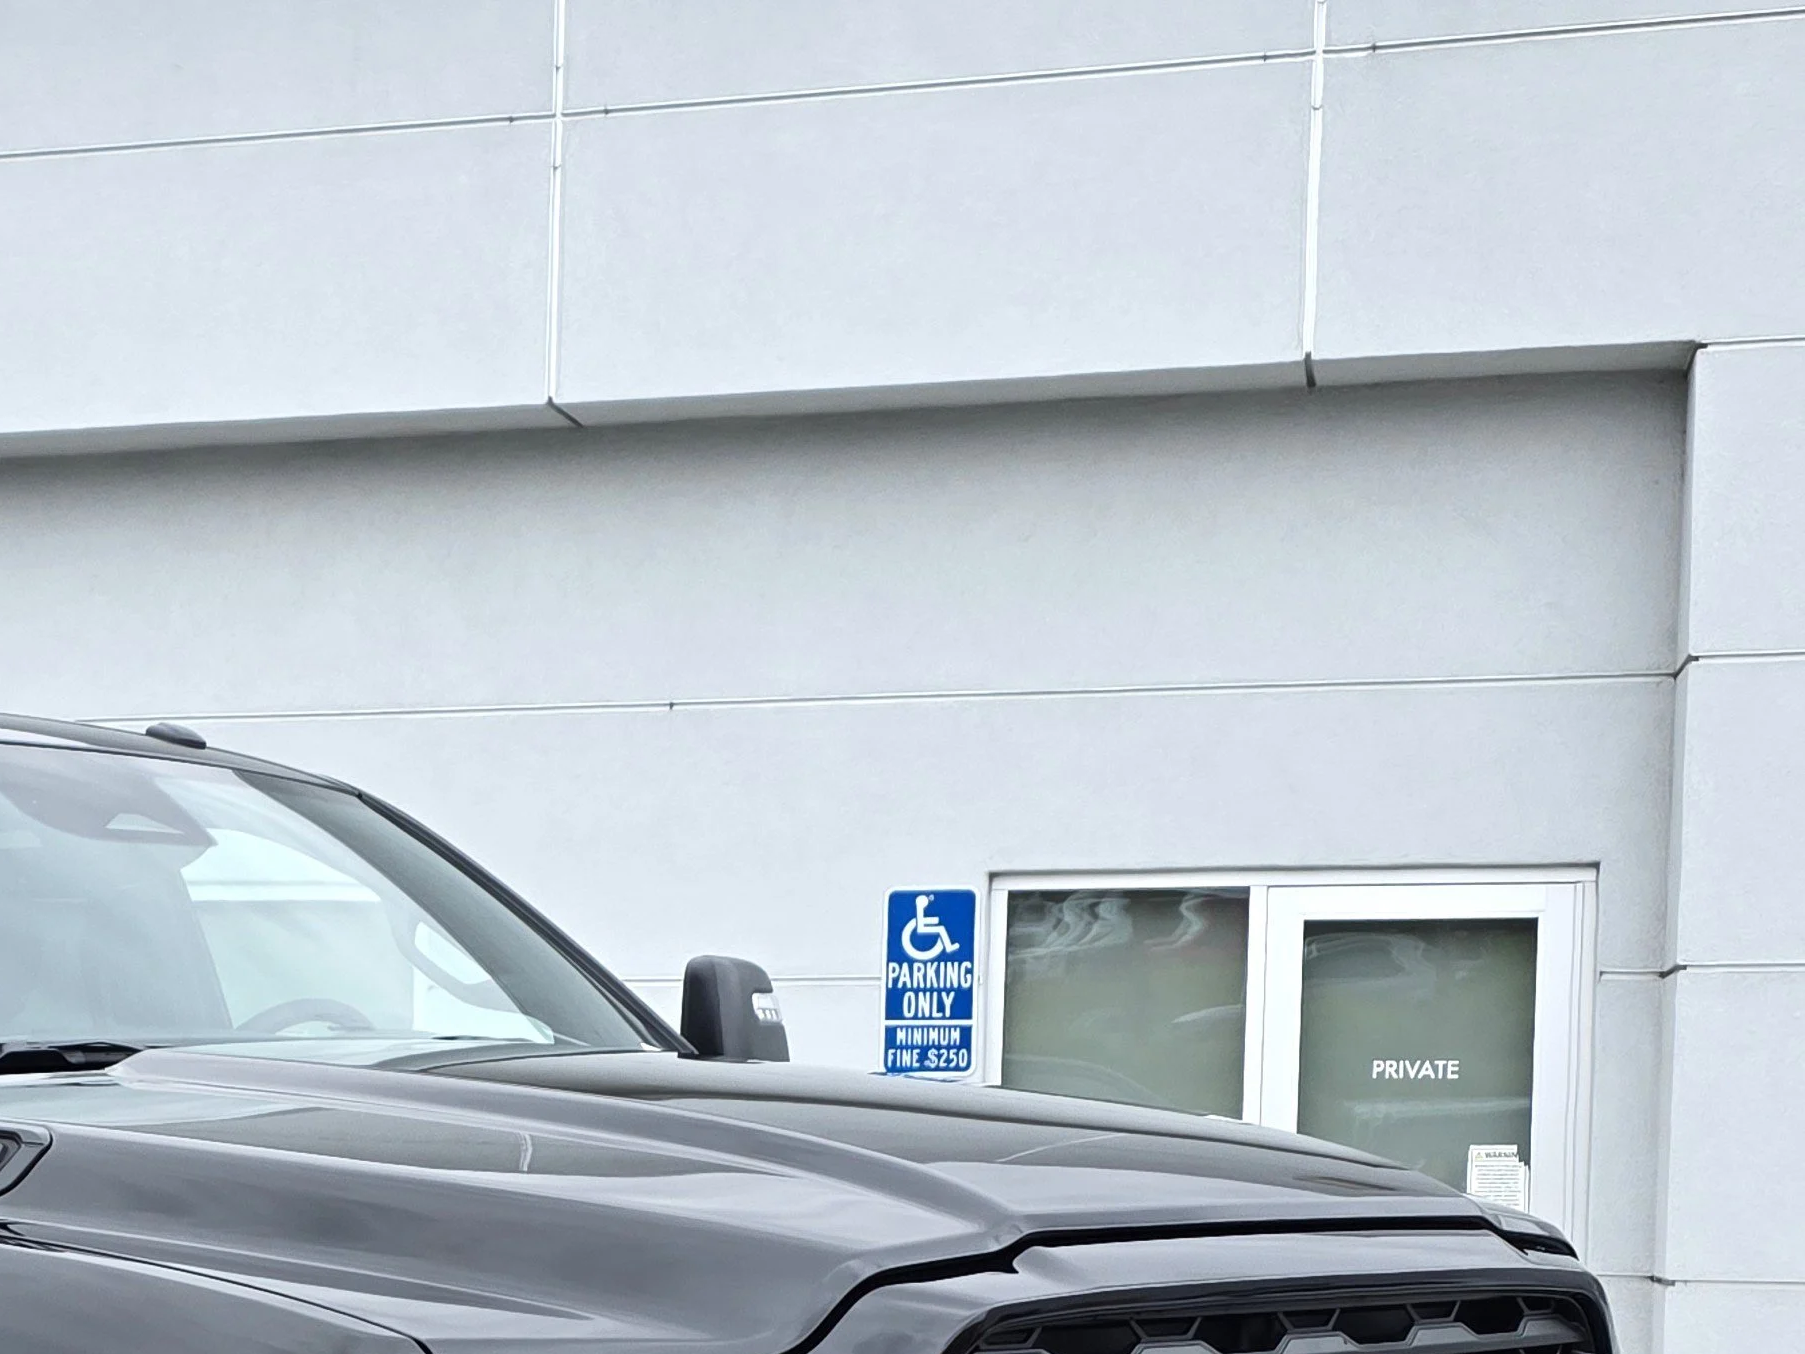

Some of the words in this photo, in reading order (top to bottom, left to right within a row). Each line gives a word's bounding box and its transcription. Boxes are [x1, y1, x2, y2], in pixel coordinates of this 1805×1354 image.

[887, 961, 972, 989] PARKING
[902, 991, 955, 1018] ONLY
[896, 1027, 960, 1046] MINIMUM
[887, 1048, 921, 1068] FINE
[928, 1047, 968, 1068] $250
[1372, 1059, 1460, 1080] PRIVATE
